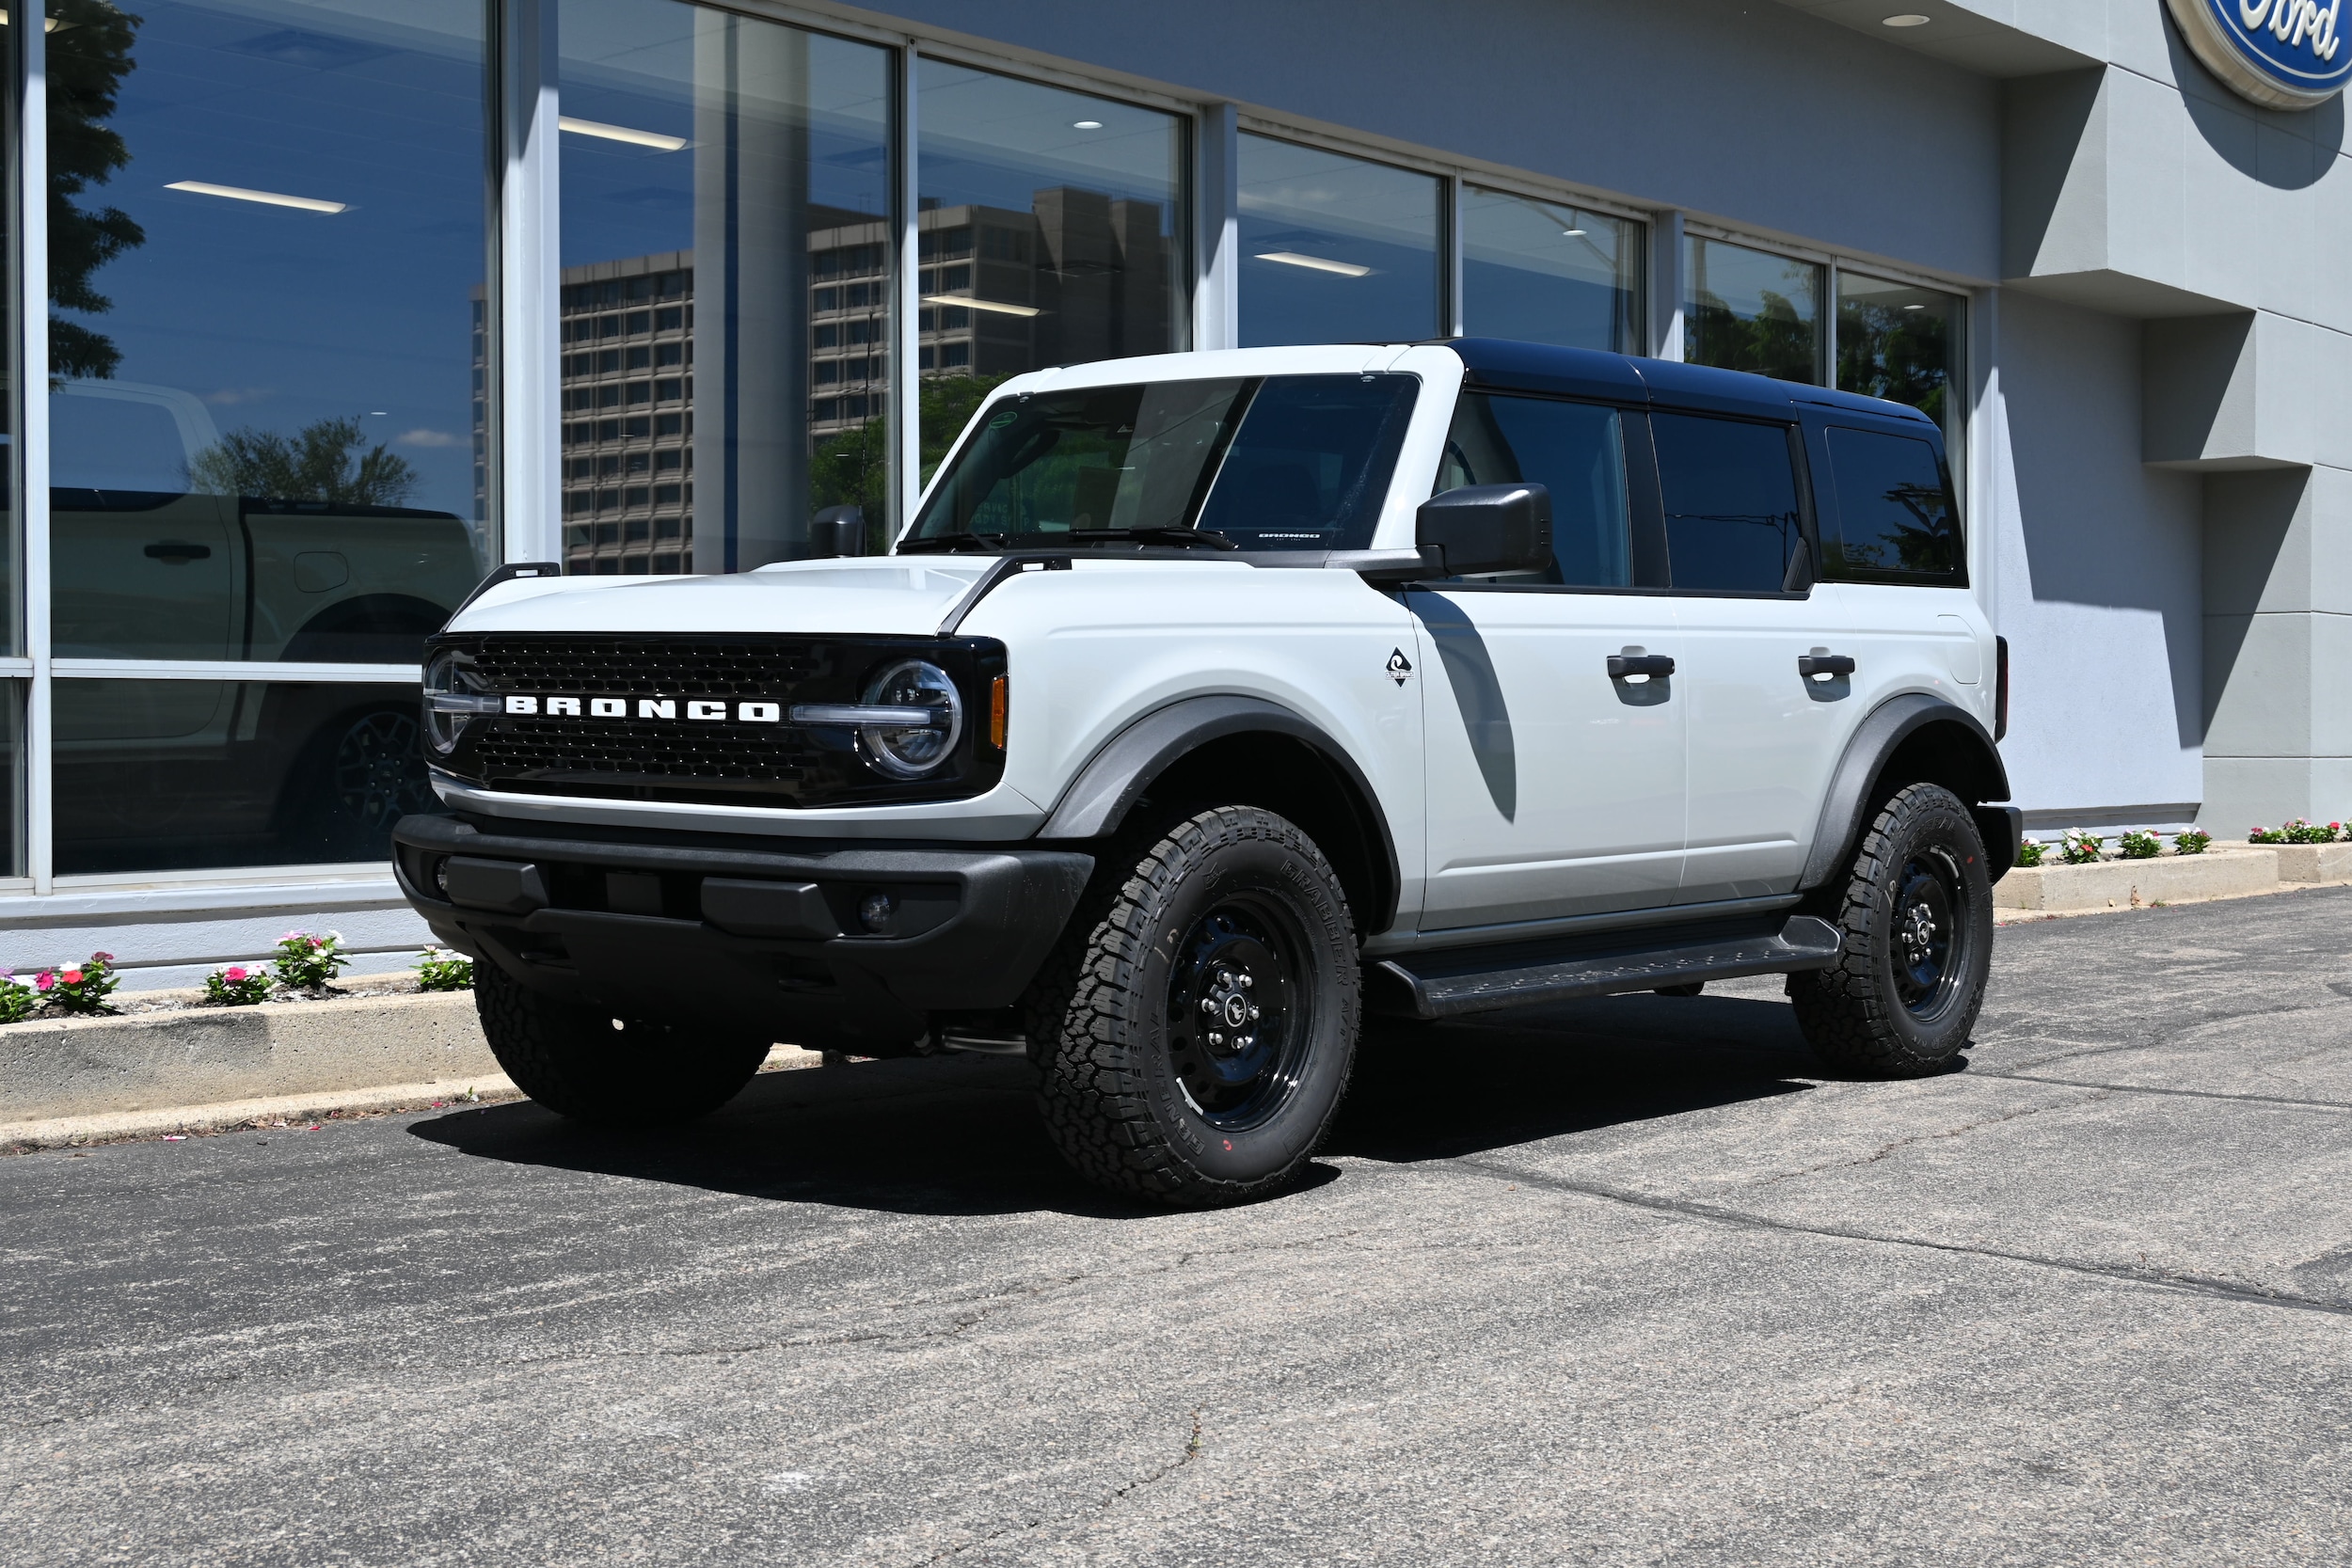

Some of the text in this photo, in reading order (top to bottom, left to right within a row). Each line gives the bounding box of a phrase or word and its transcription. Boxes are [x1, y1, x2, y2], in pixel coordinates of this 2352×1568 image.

[505, 695, 780, 722] BRONCO
[1280, 859, 1348, 987] GRABBER
[1149, 1000, 1206, 1157] GENERAL
